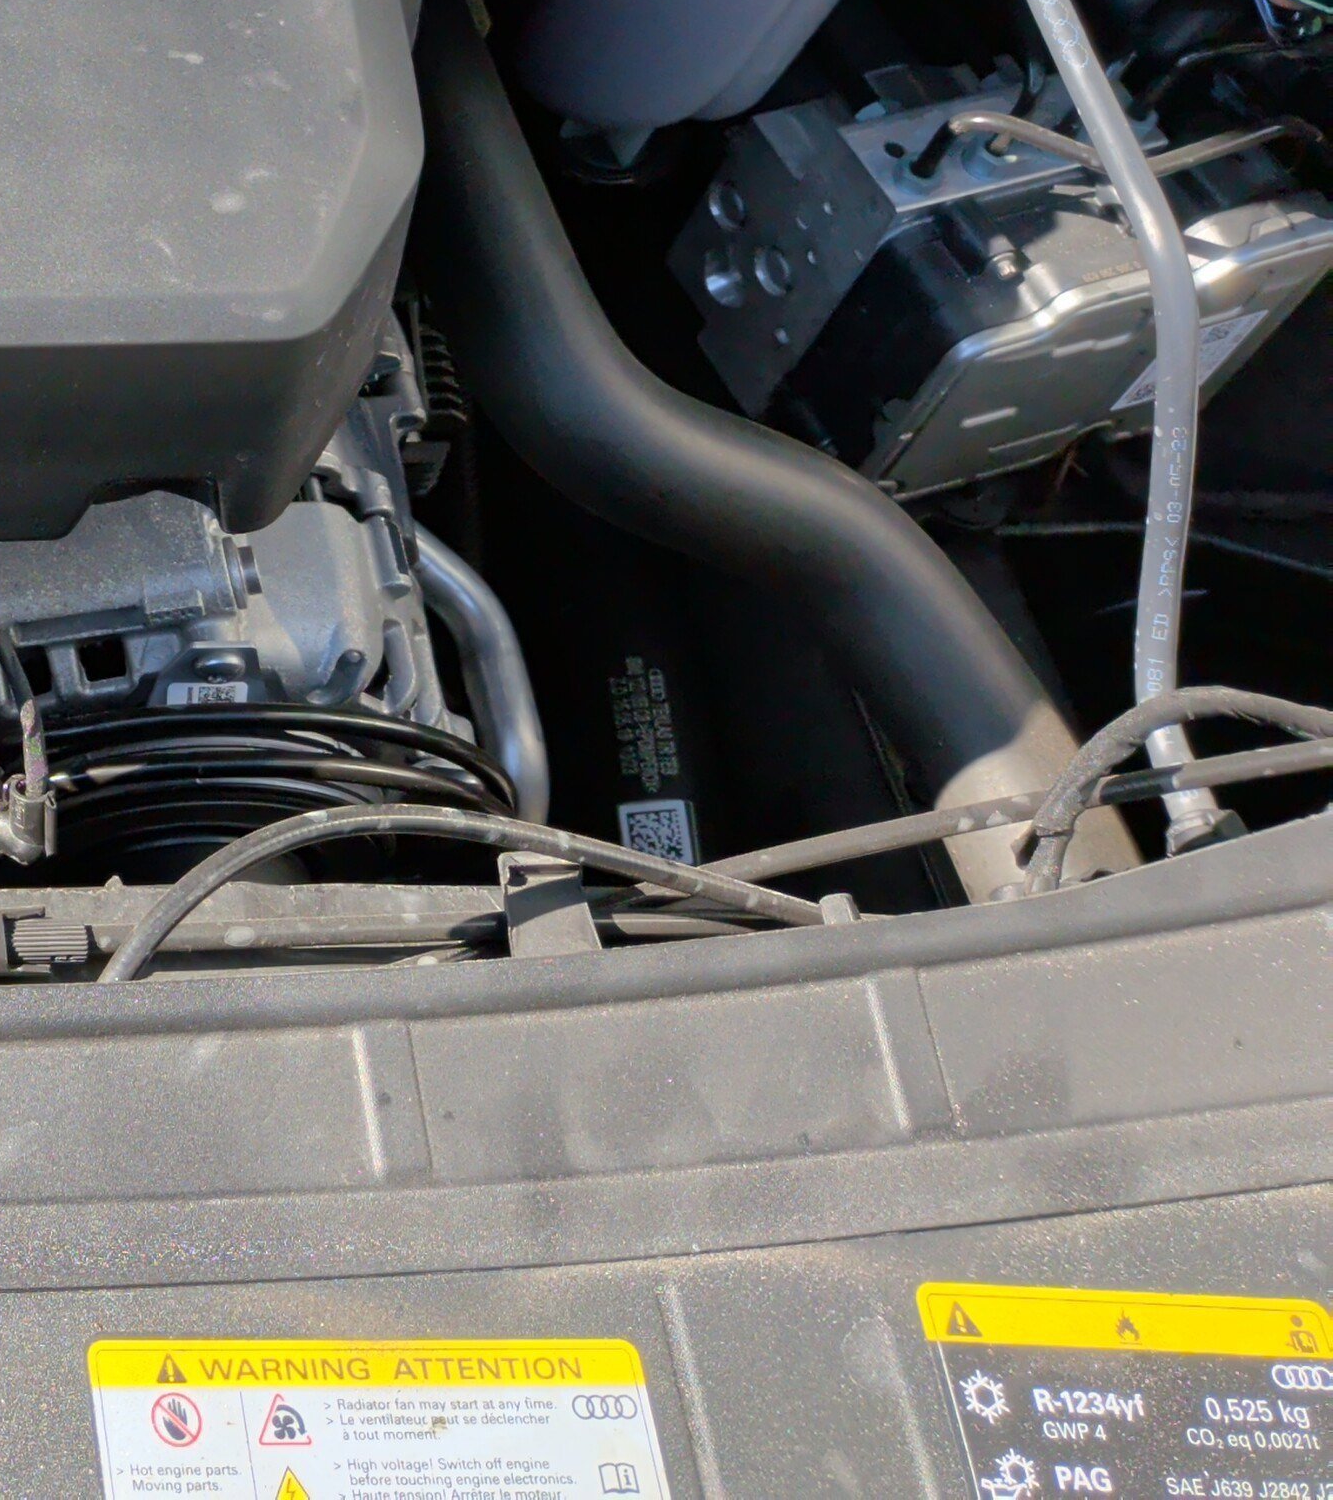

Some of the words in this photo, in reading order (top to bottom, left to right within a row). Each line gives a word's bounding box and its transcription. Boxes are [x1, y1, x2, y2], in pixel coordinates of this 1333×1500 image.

[1151, 613, 1170, 641] ED
[1147, 658, 1164, 692] 081
[199, 1358, 371, 1381] WARNING
[394, 1357, 582, 1381] ATTENTION
[337, 1398, 391, 1411] Radiator
[394, 1398, 414, 1411] fan
[419, 1401, 446, 1412] may
[450, 1399, 478, 1411] start
[482, 1400, 495, 1411] at
[498, 1401, 521, 1412] any
[525, 1397, 557, 1411] time.
[1032, 1389, 1145, 1422] R-1234yf
[1204, 1397, 1273, 1424] 0,525
[1278, 1400, 1311, 1429] kg
[339, 1414, 355, 1425] Le
[359, 1414, 427, 1425] ventilateur
[462, 1415, 477, 1425] se
[481, 1413, 551, 1425] déclencher
[353, 1430, 379, 1440] tout
[383, 1430, 441, 1441] moment.
[1043, 1420, 1089, 1440] GWP
[1095, 1424, 1107, 1441] 4
[1227, 1433, 1252, 1451] eq
[130, 1464, 154, 1477] Hot
[157, 1465, 202, 1478] engine
[206, 1465, 242, 1478] parts.
[347, 1458, 377, 1473] High
[382, 1458, 433, 1472] voltage!
[438, 1458, 481, 1470] Switch
[485, 1458, 502, 1470] off
[506, 1460, 550, 1472] engine
[132, 1480, 181, 1493] Moving
[186, 1480, 223, 1493] parts.
[349, 1473, 392, 1485] before
[395, 1474, 452, 1487] touching
[455, 1474, 500, 1487] engine
[504, 1473, 577, 1485] electronics.
[1054, 1465, 1113, 1492] PAG
[1166, 1476, 1205, 1497] SAE
[1211, 1478, 1253, 1499] J639
[1259, 1481, 1310, 1499] J2842
[352, 1489, 391, 1500] Haute
[451, 1488, 496, 1500] Arrêter
[499, 1488, 511, 1500] le
